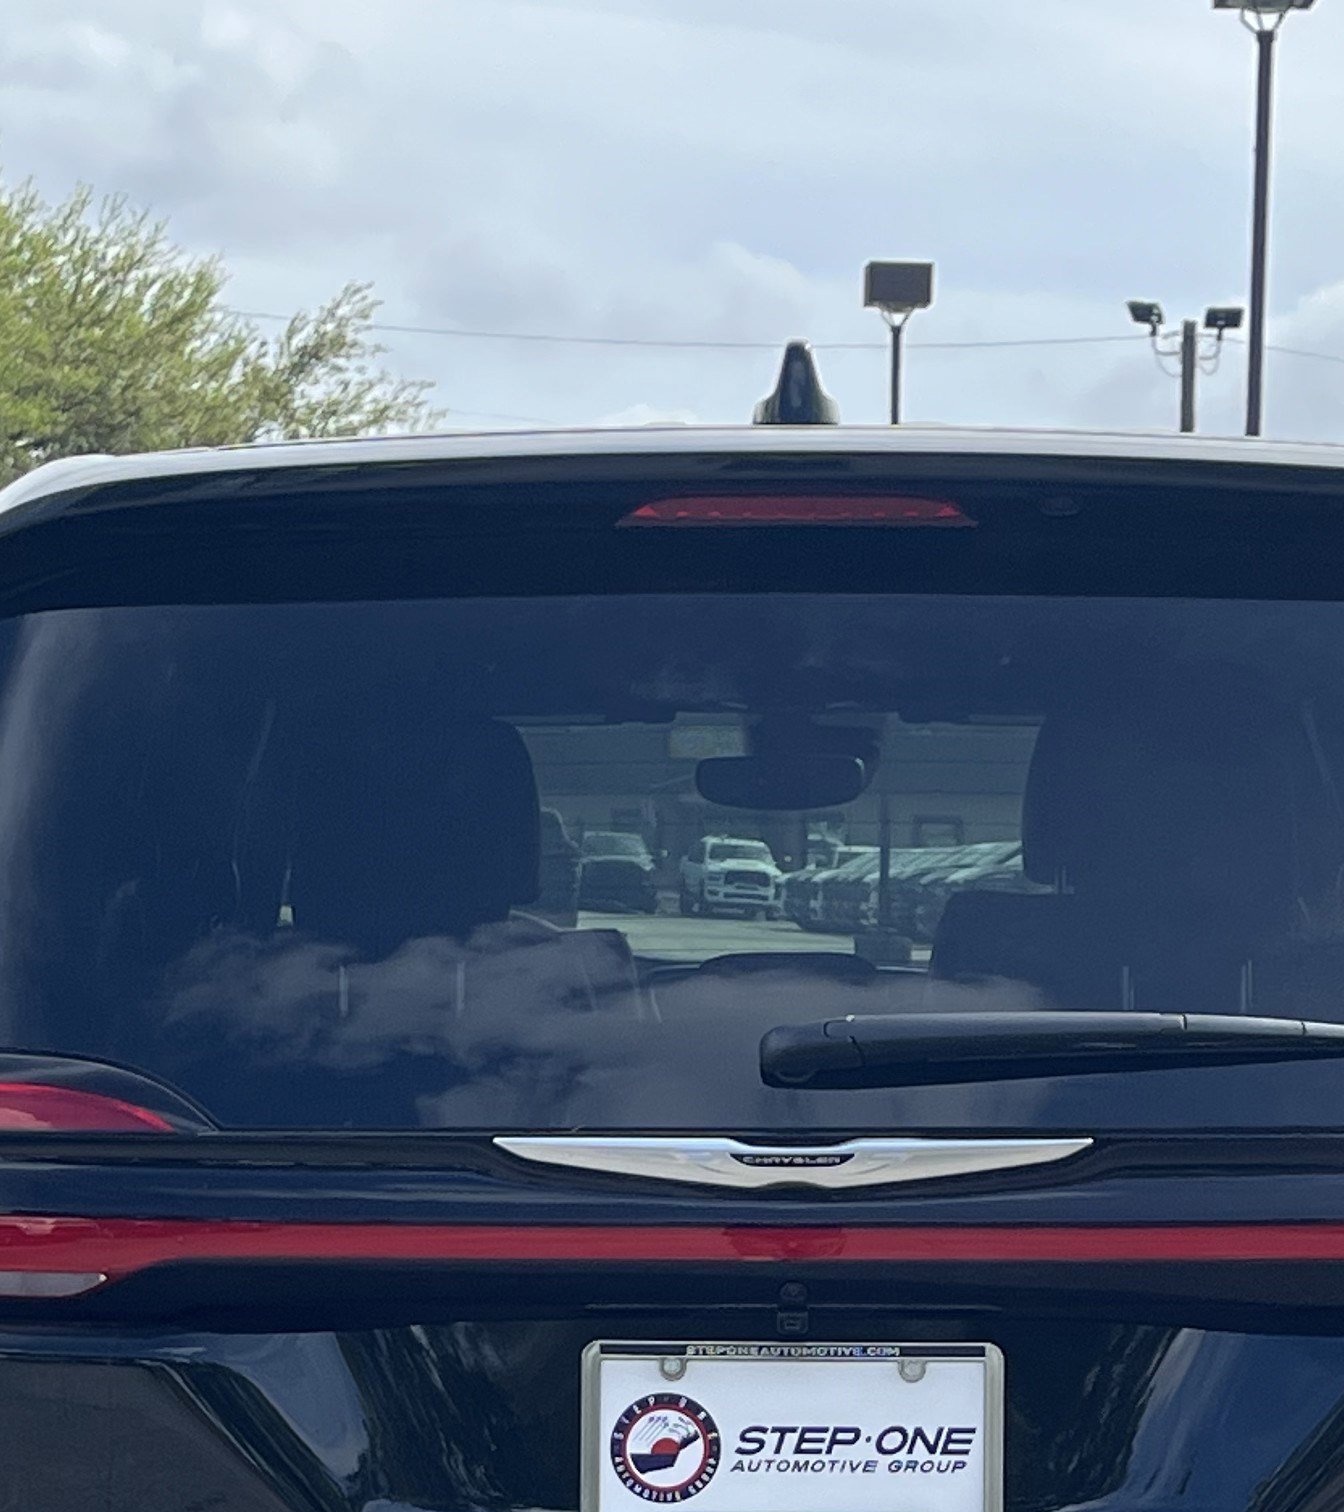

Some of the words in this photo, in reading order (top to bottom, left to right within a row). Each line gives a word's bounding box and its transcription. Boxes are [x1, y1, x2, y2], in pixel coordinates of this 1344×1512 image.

[686, 1345, 900, 1357] STEPONEAUTOMOTIVE.COM
[730, 1459, 879, 1474] AUTOMOTIVE
[887, 1459, 968, 1474] GROUP
